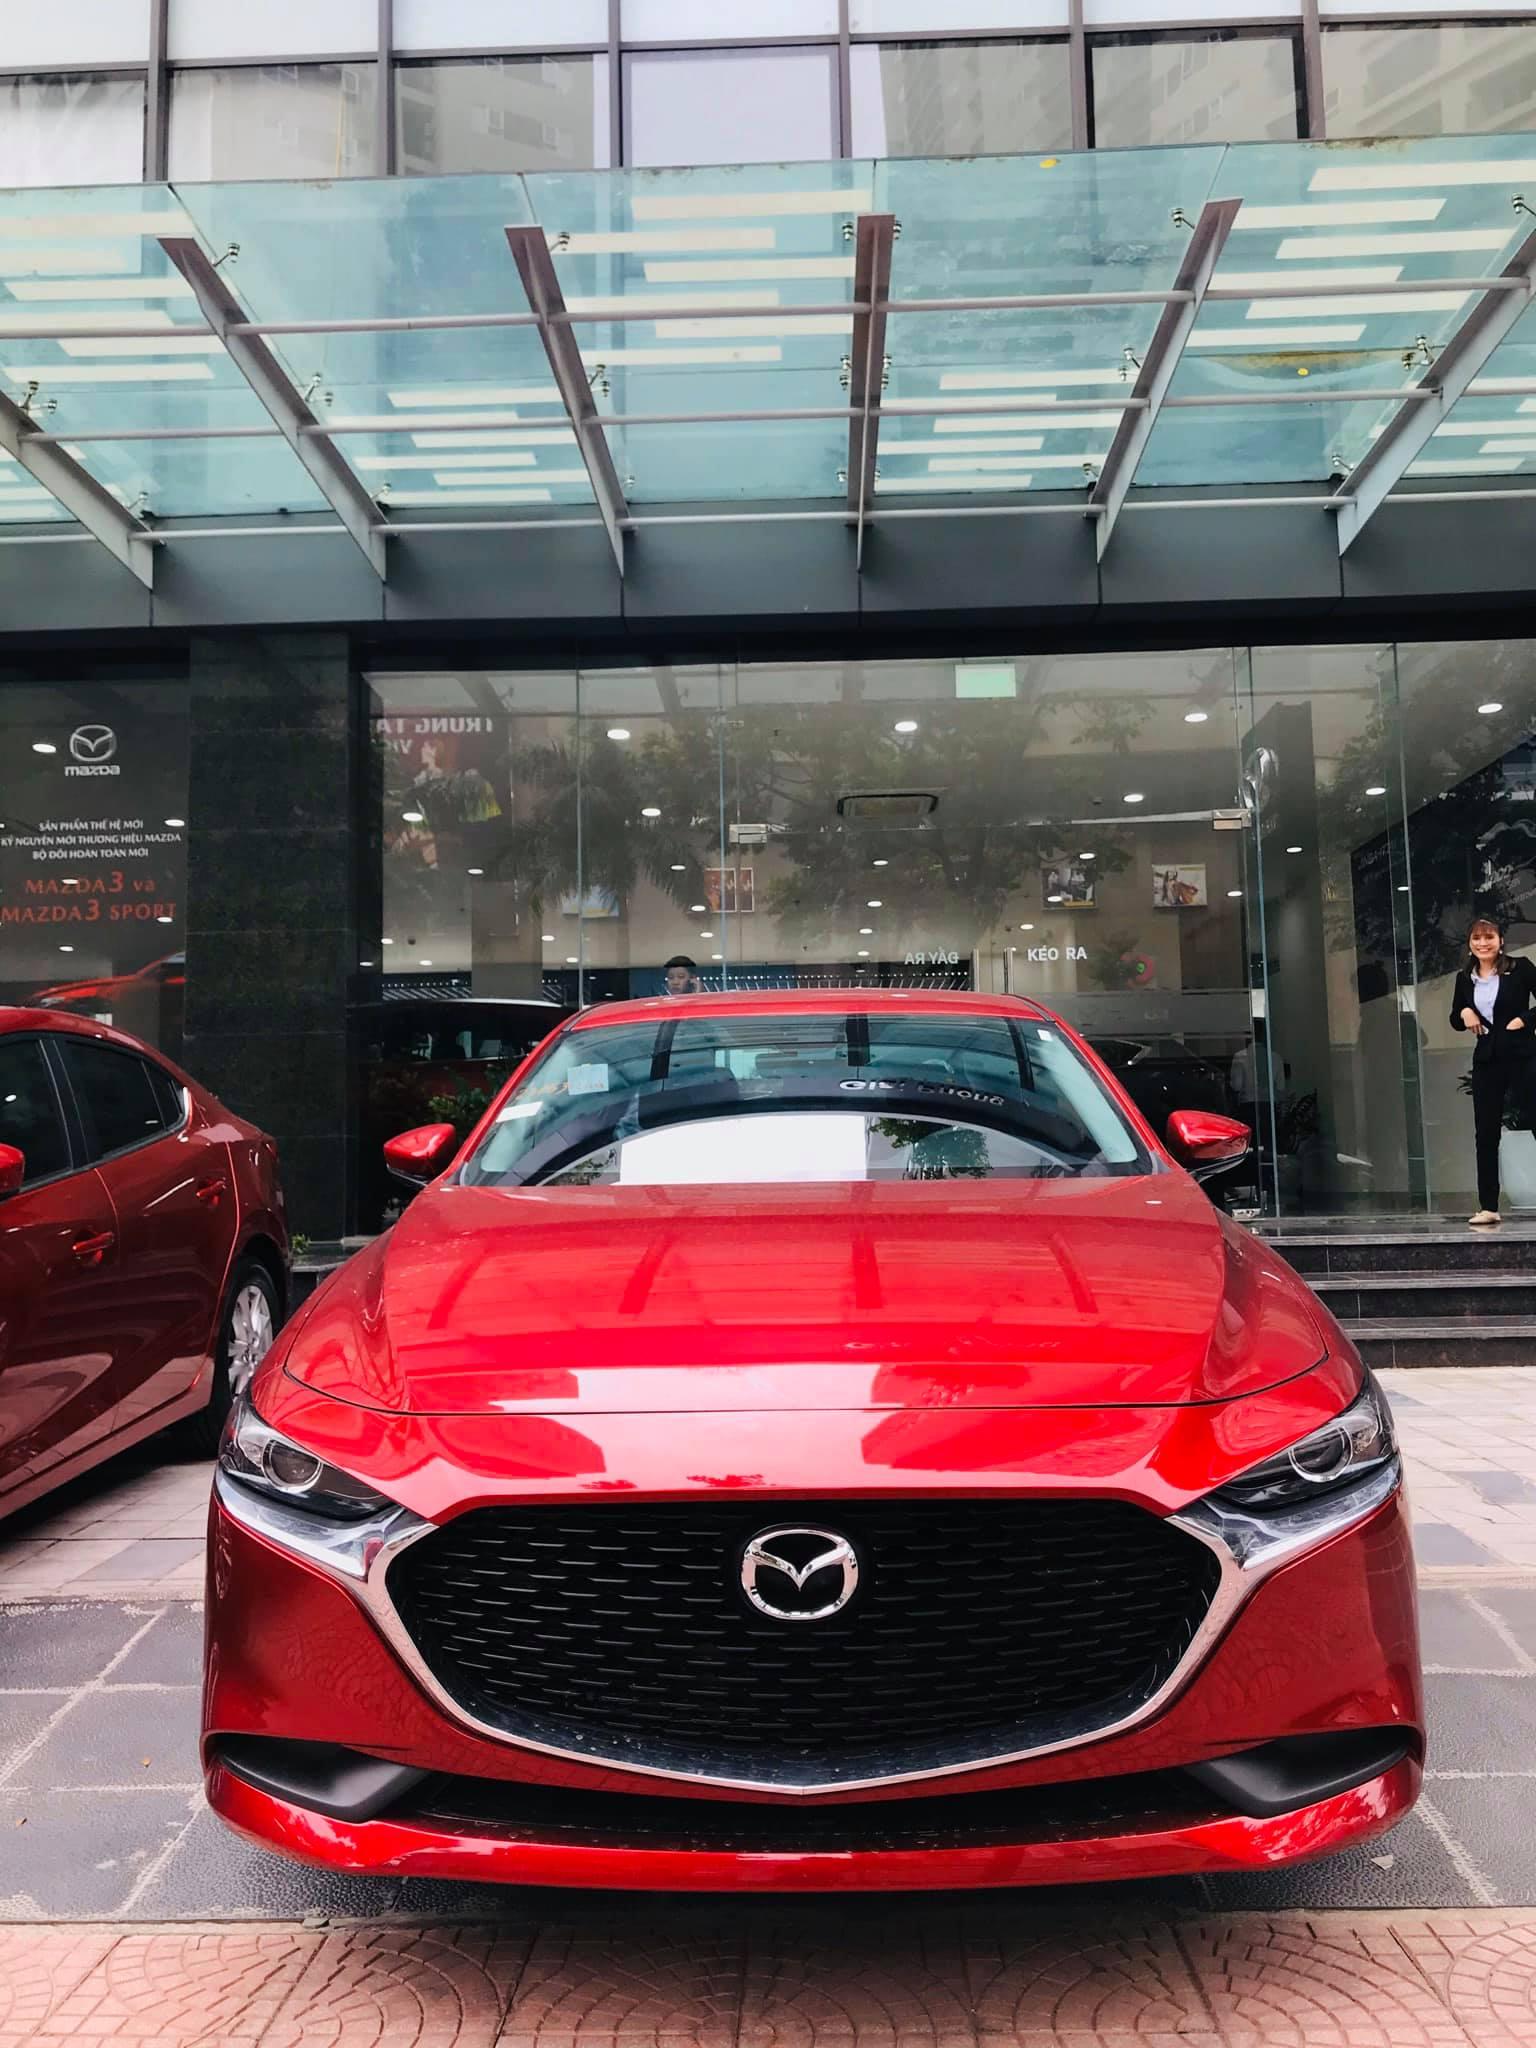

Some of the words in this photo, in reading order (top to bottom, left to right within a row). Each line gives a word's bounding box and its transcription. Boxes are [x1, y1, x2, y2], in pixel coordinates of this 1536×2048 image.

[64, 764, 121, 777] mazda
[144, 832, 182, 843] MAZDA
[1, 899, 101, 922] MAZDA3
[1027, 946, 1060, 962] KÉO
[1065, 948, 1088, 960] RA
